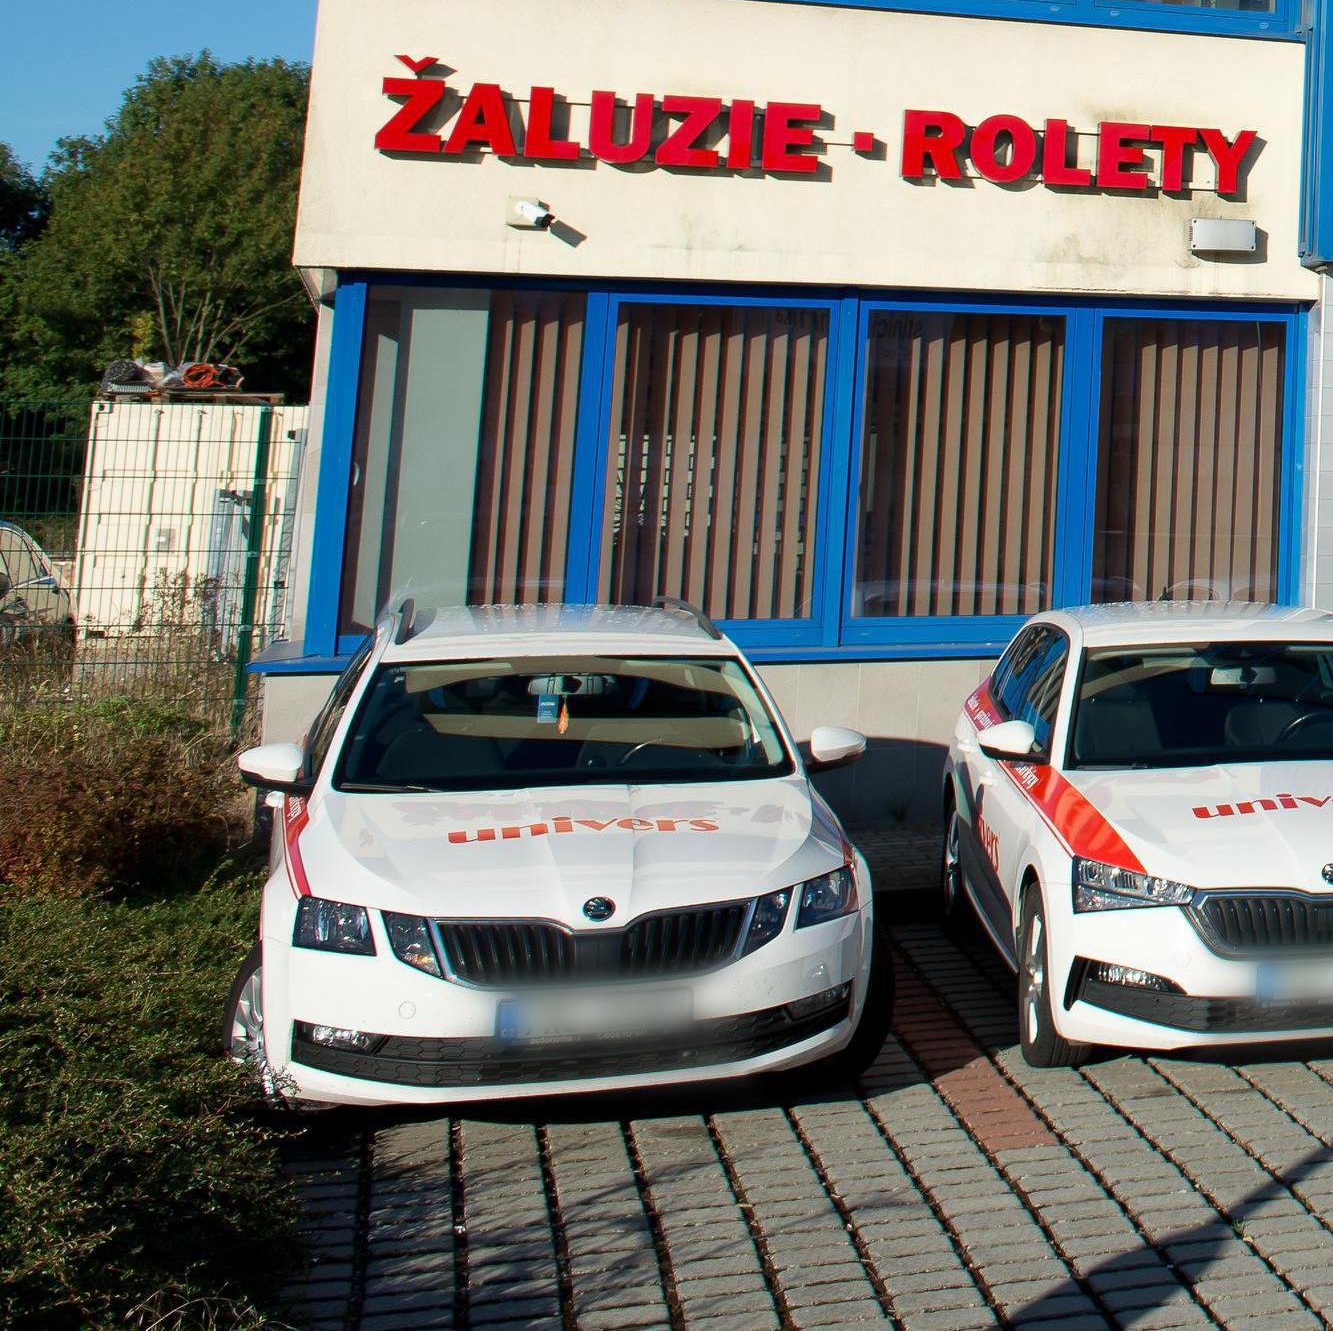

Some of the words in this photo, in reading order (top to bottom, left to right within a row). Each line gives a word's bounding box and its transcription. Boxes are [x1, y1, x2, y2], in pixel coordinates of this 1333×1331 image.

[374, 54, 822, 173] ŽALUZIE
[901, 108, 1257, 195] ROLETY
[447, 816, 720, 844] univers
